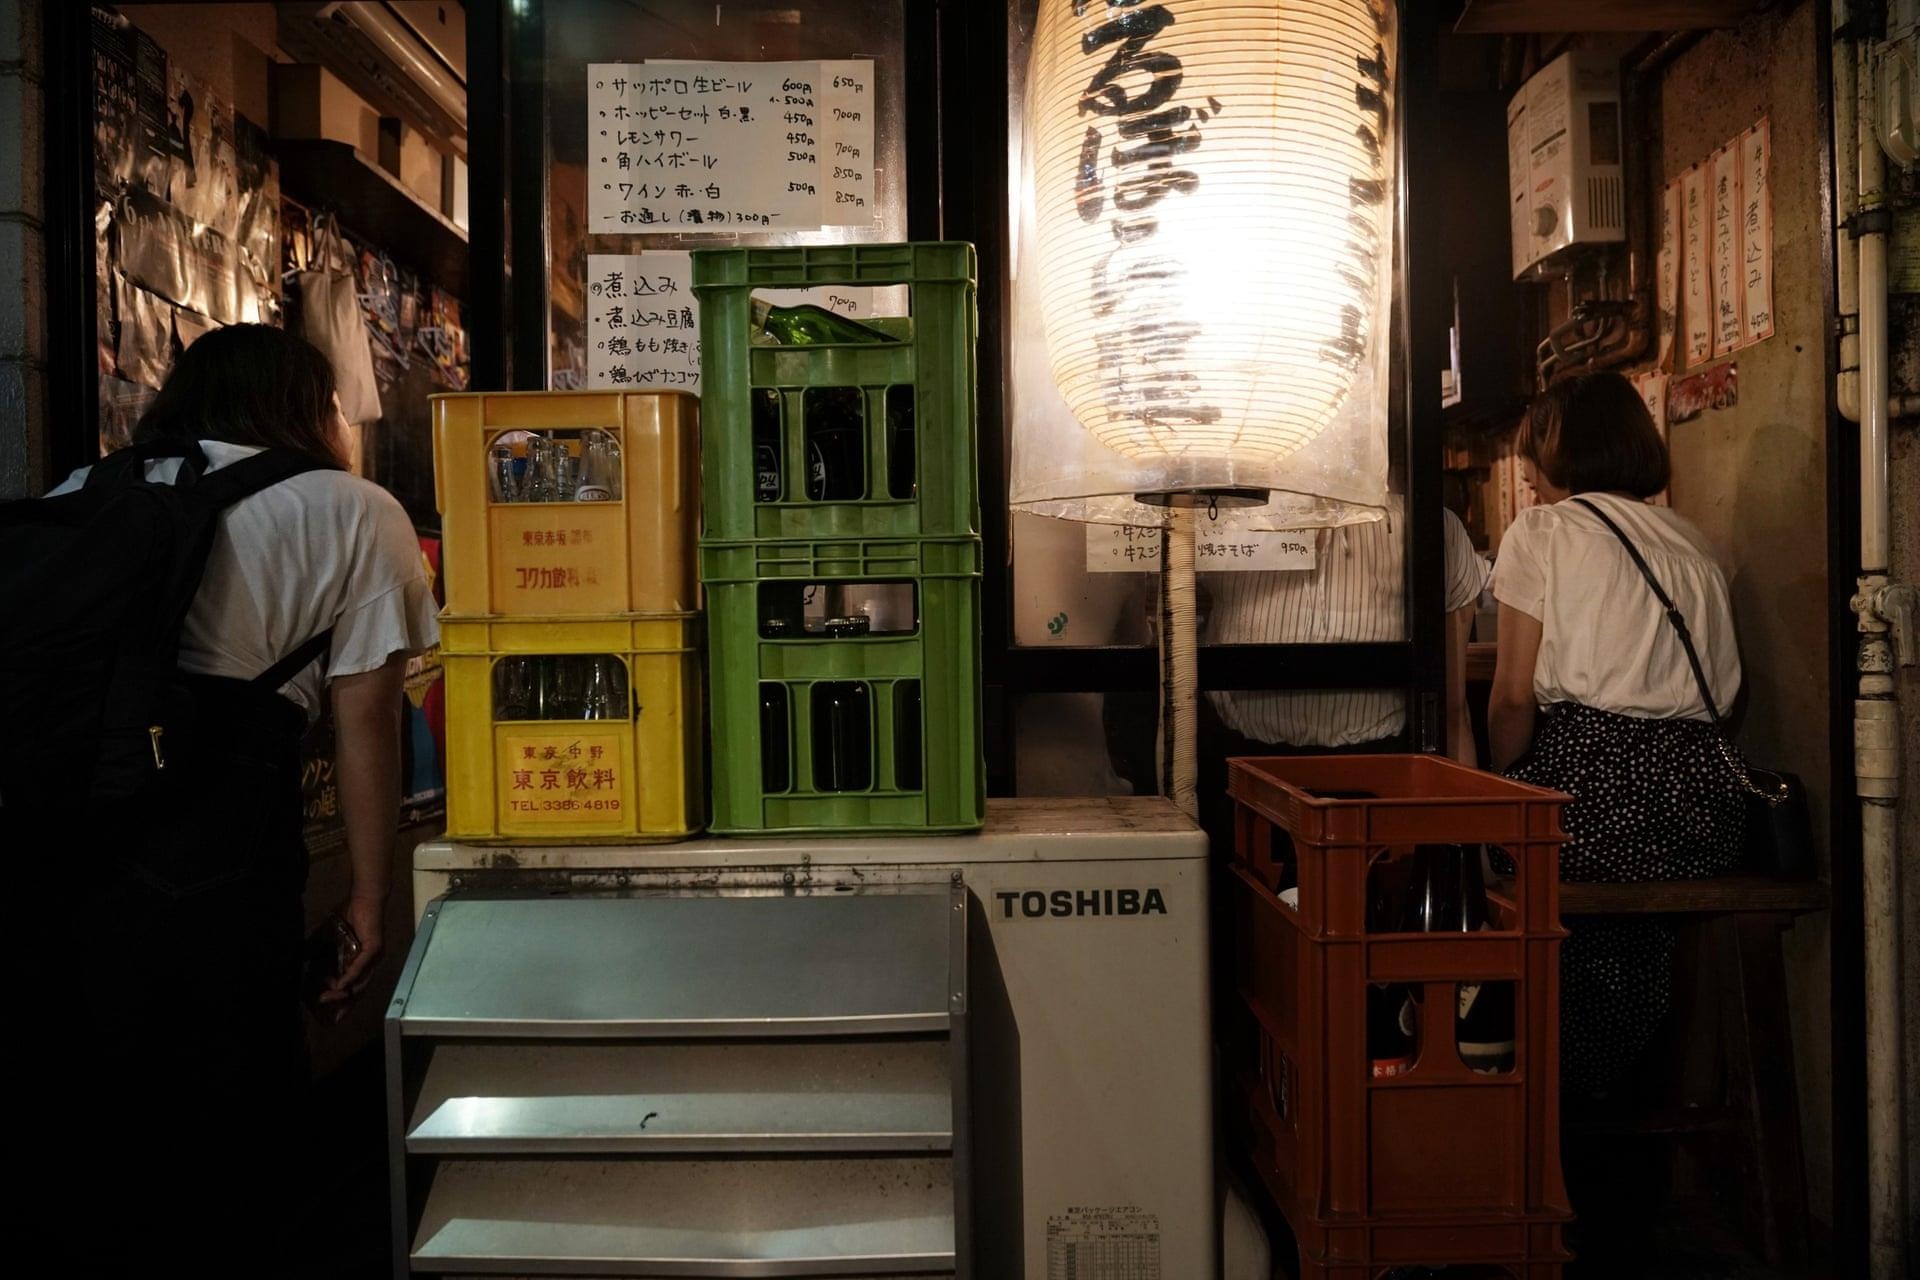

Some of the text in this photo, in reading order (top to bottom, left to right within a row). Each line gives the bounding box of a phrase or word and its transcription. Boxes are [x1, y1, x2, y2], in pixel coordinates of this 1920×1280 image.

[612, 75, 863, 97] サッポロ生ビール 600円 650円
[784, 111, 813, 126] 450円
[833, 108, 861, 121] 700円
[617, 130, 860, 159] レモンサワー 450円 700円
[617, 152, 862, 181] 角ハイボール 500円 850円
[787, 182, 815, 195] 500円
[835, 191, 864, 207] 850円
[603, 272, 678, 298] 煮込み
[605, 306, 695, 330] 煮込み豆腐
[512, 768, 616, 790] 東京飲料
[510, 800, 540, 811] TEL
[584, 799, 620, 810] 4819
[997, 888, 1168, 918] TOSHIBA
